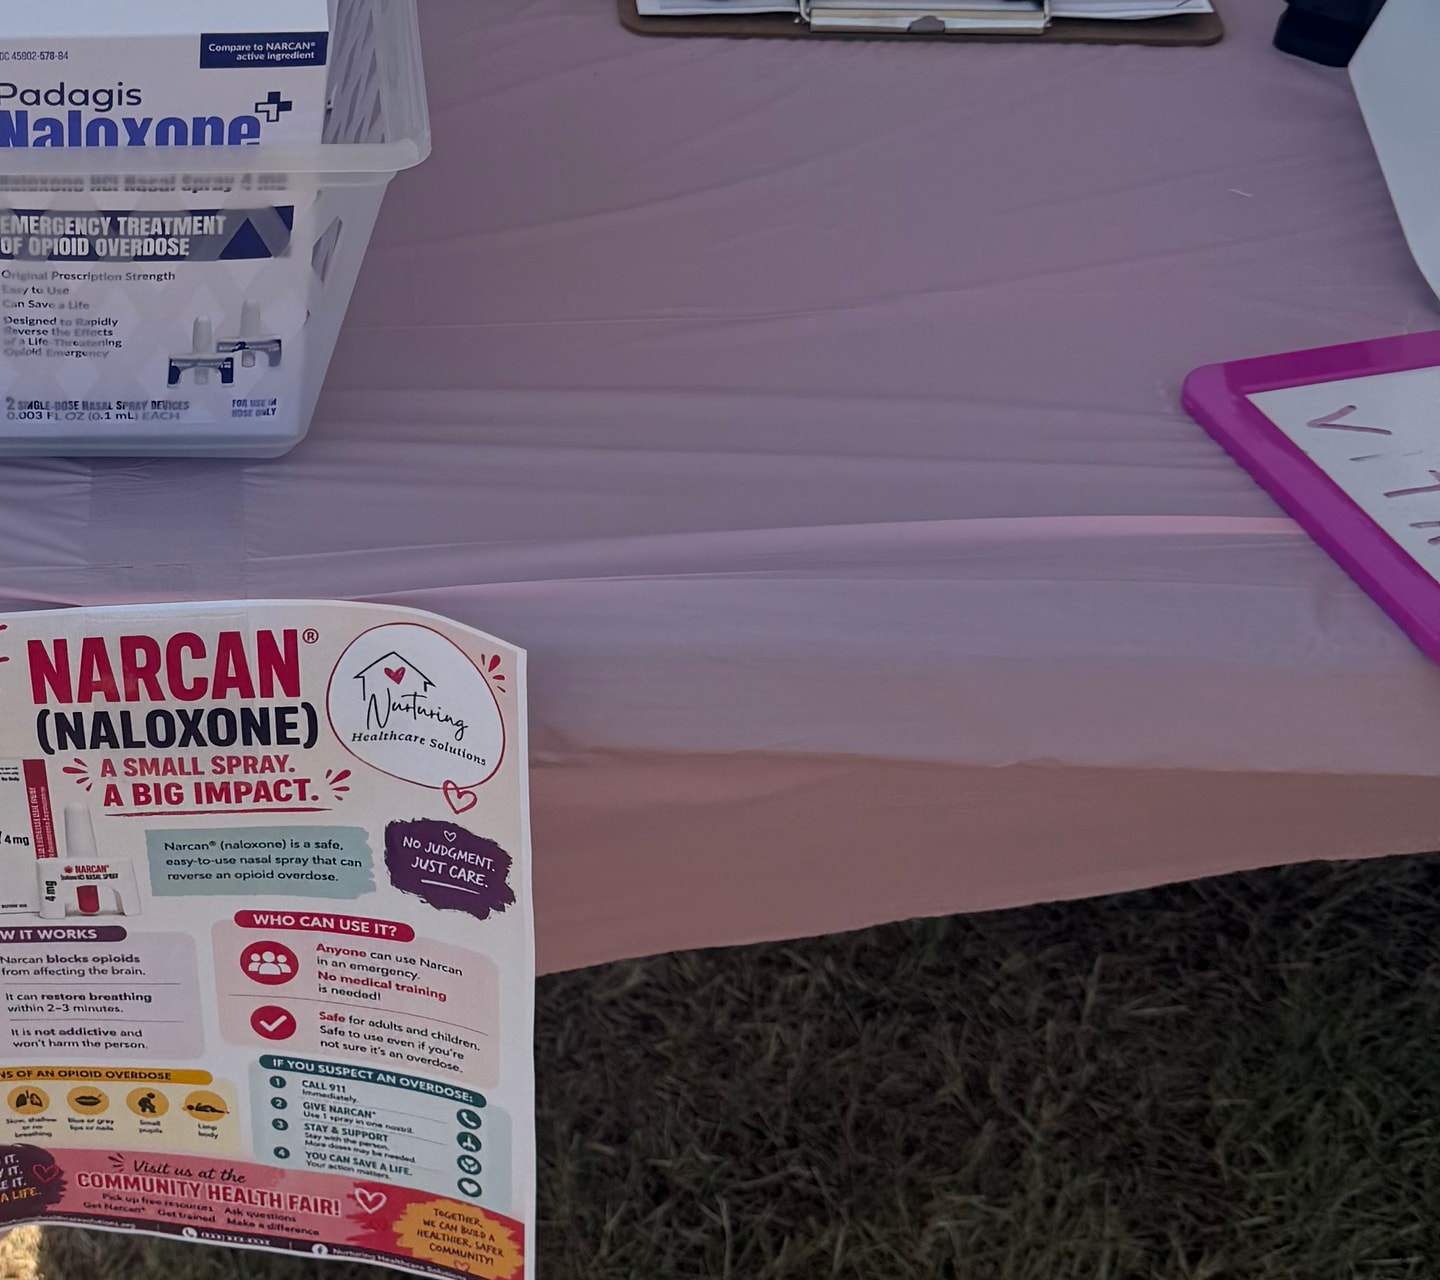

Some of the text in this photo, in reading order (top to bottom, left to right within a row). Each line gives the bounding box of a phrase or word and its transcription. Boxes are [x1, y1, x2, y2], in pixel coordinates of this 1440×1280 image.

[209, 43, 251, 53] Compare
[253, 43, 263, 51] to
[236, 51, 315, 61] active ingredient
[0, 215, 226, 236] EMERGENCY TREATMENT
[0, 238, 190, 257] OF OPIOID OVERDOSE
[1, 270, 175, 283] Original Prescription Strength
[367, 688, 468, 741] Nurturing
[37, 702, 318, 755] (NALOXONE)
[351, 731, 486, 766] Healthcare Solutions
[101, 754, 296, 777] A SMALL SPRAY.
[104, 779, 319, 806] A BIG IMPACT.
[4, 835, 11, 844] 4
[12, 836, 29, 846] mg
[220, 839, 286, 851] (naloxone)
[290, 839, 300, 849] is
[303, 841, 311, 849] a
[166, 855, 362, 867] easy-to-use nasal spray that can
[403, 836, 495, 872] NO JUDGMENT.
[168, 870, 339, 882] reverse an opioid overdose.
[411, 857, 488, 888] JUST CARE.
[20, 929, 33, 940] IT
[37, 929, 98, 940] WORKS
[253, 914, 397, 937] WHO CAN USE IT?
[0, 954, 141, 964] Narcan blocks opioids
[316, 943, 463, 976] Anyone can use Narcan
[2, 967, 146, 978] from affecting the brain.
[317, 957, 420, 982] in an emergency.
[317, 971, 447, 1002] No medical training
[318, 984, 382, 1001] is needed!
[16, 1070, 34, 1079] OF
[36, 1070, 55, 1078] AN
[58, 1069, 102, 1080] OPIOID
[105, 1070, 172, 1081] OVERDOSE
[272, 1058, 473, 1103] IF YOU SUSPECT AN OVERDOSE:
[274, 1078, 346, 1093] 1 CALL 911
[275, 1099, 283, 1108] 2
[303, 1101, 326, 1113] GIVE
[276, 1120, 388, 1143] 3 STAY & SUPPORT
[4, 1154, 19, 1165] IT.
[277, 1148, 412, 1176] 4 YOU CAN SAVE A LIFE.
[8, 1166, 24, 1176] IT.
[133, 1160, 247, 1184] Visit us at the
[12, 1177, 27, 1187] IT.
[0, 1194, 9, 1204] A
[13, 1187, 42, 1200] LIFE.
[77, 1172, 341, 1216] COMMUNITY HEALTH FAIR!
[433, 1207, 484, 1229] TOGETHER,
[423, 1218, 496, 1242] WE CAN BUILD A
[430, 1242, 495, 1266] COMMUNITY!
[475, 1240, 505, 1258] SAFER
